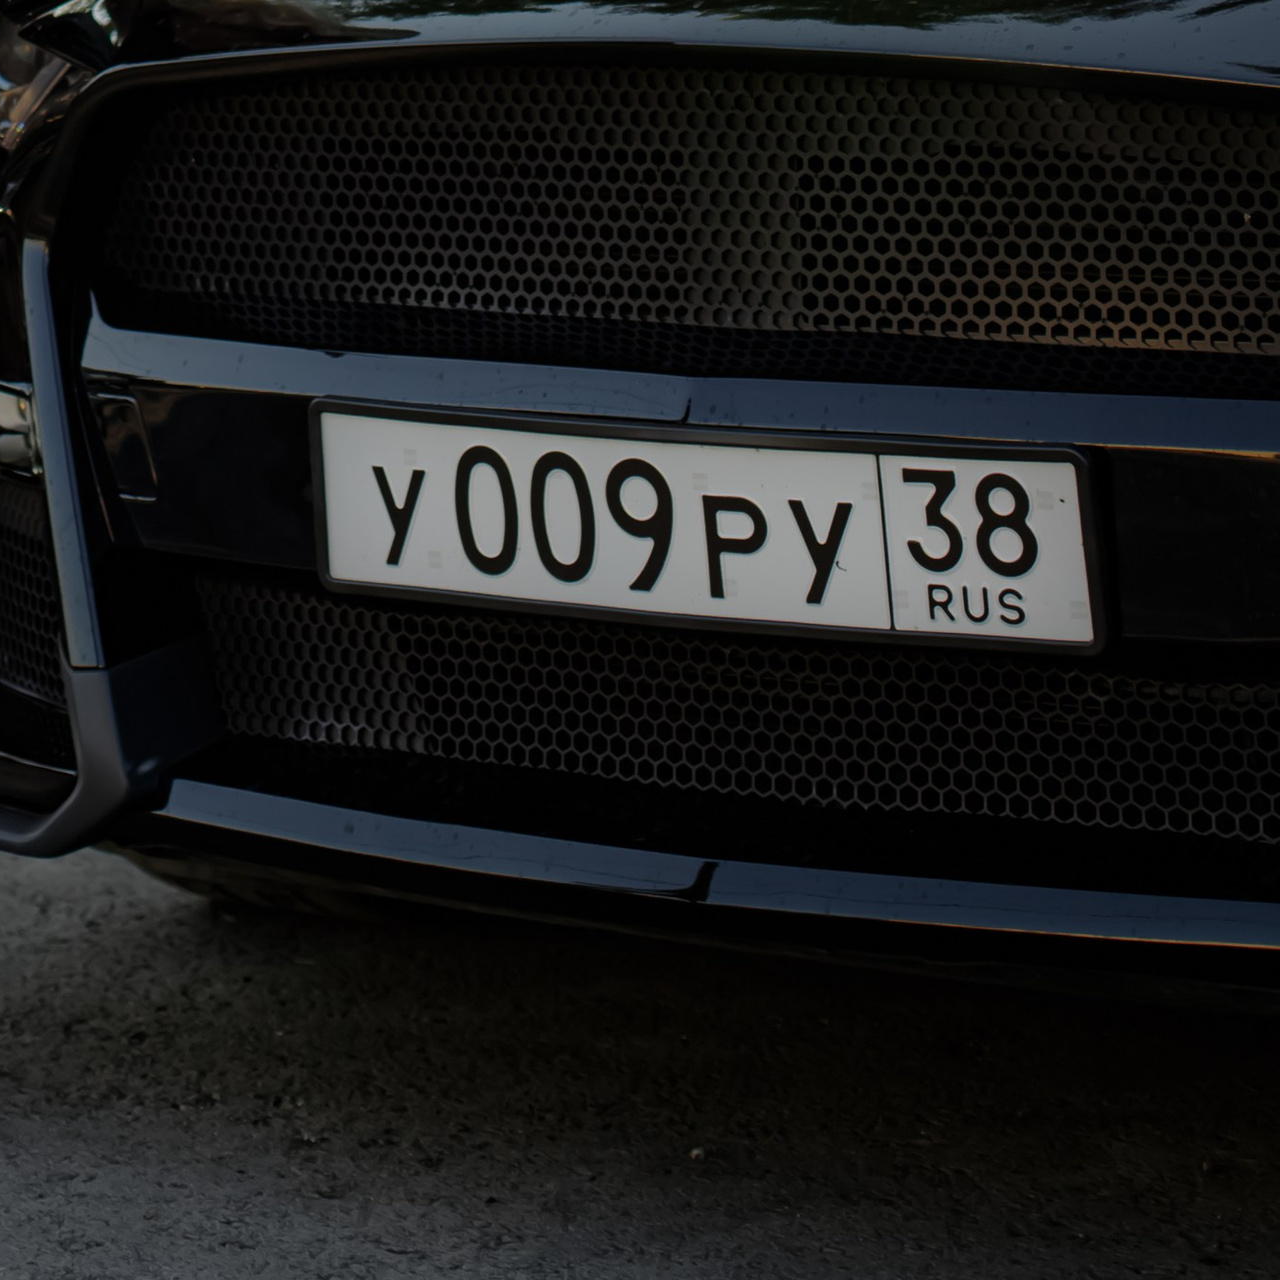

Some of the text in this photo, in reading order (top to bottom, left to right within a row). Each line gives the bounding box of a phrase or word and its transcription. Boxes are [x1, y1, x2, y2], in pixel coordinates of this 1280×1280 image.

[370, 444, 1040, 606] У009РУ 38
[926, 582, 1027, 627] RUS
